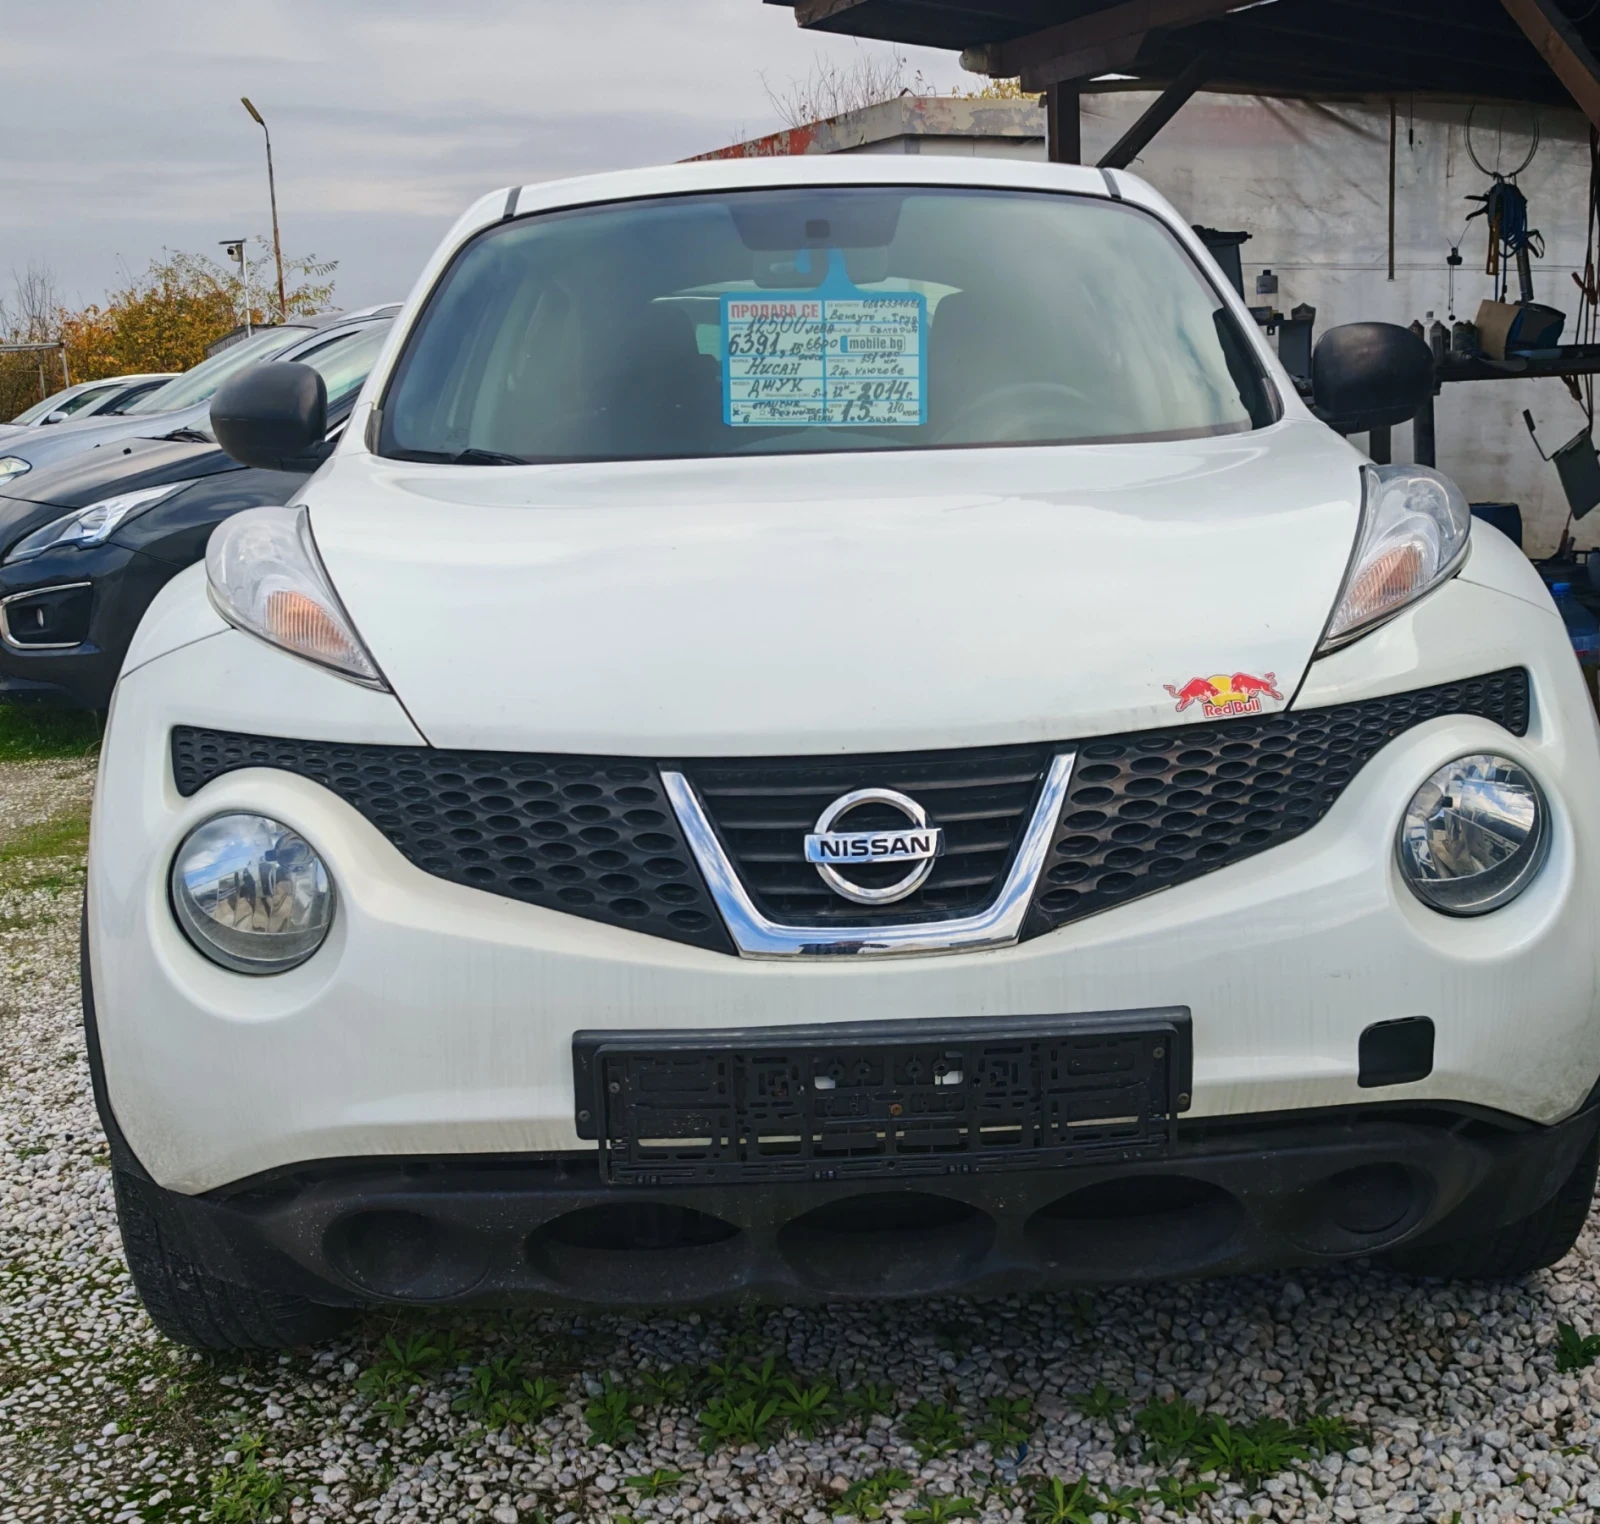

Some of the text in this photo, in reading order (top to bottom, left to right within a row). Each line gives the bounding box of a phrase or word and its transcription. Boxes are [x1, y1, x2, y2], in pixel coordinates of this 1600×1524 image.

[731, 303, 819, 319] ПРОДАВА СЕ
[747, 312, 807, 335] 12500
[849, 337, 904, 351] mobile.bg
[1204, 700, 1260, 717] Red Bull
[820, 836, 930, 857] NISSAN
